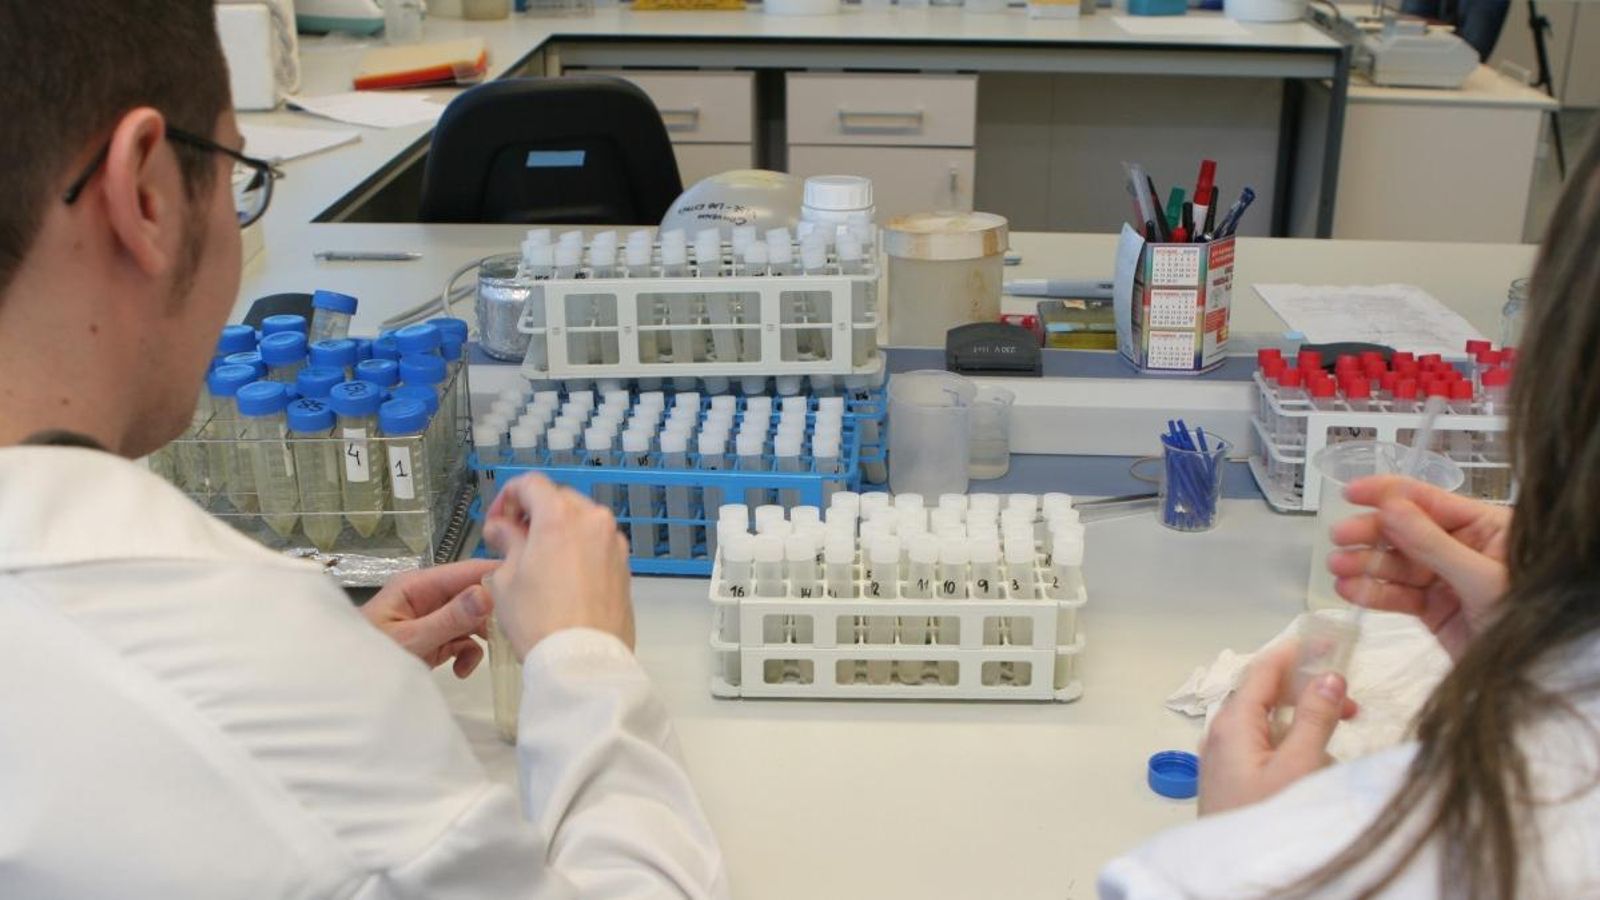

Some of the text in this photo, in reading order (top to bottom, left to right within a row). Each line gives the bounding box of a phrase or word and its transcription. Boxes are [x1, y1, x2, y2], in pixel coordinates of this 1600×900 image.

[347, 443, 361, 466] 4
[394, 460, 408, 477] 1
[917, 579, 929, 591] 11
[943, 580, 956, 594] 10
[977, 578, 989, 593] 9
[1011, 578, 1020, 591] 3
[1052, 576, 1060, 589] 2
[729, 585, 745, 598] 16
